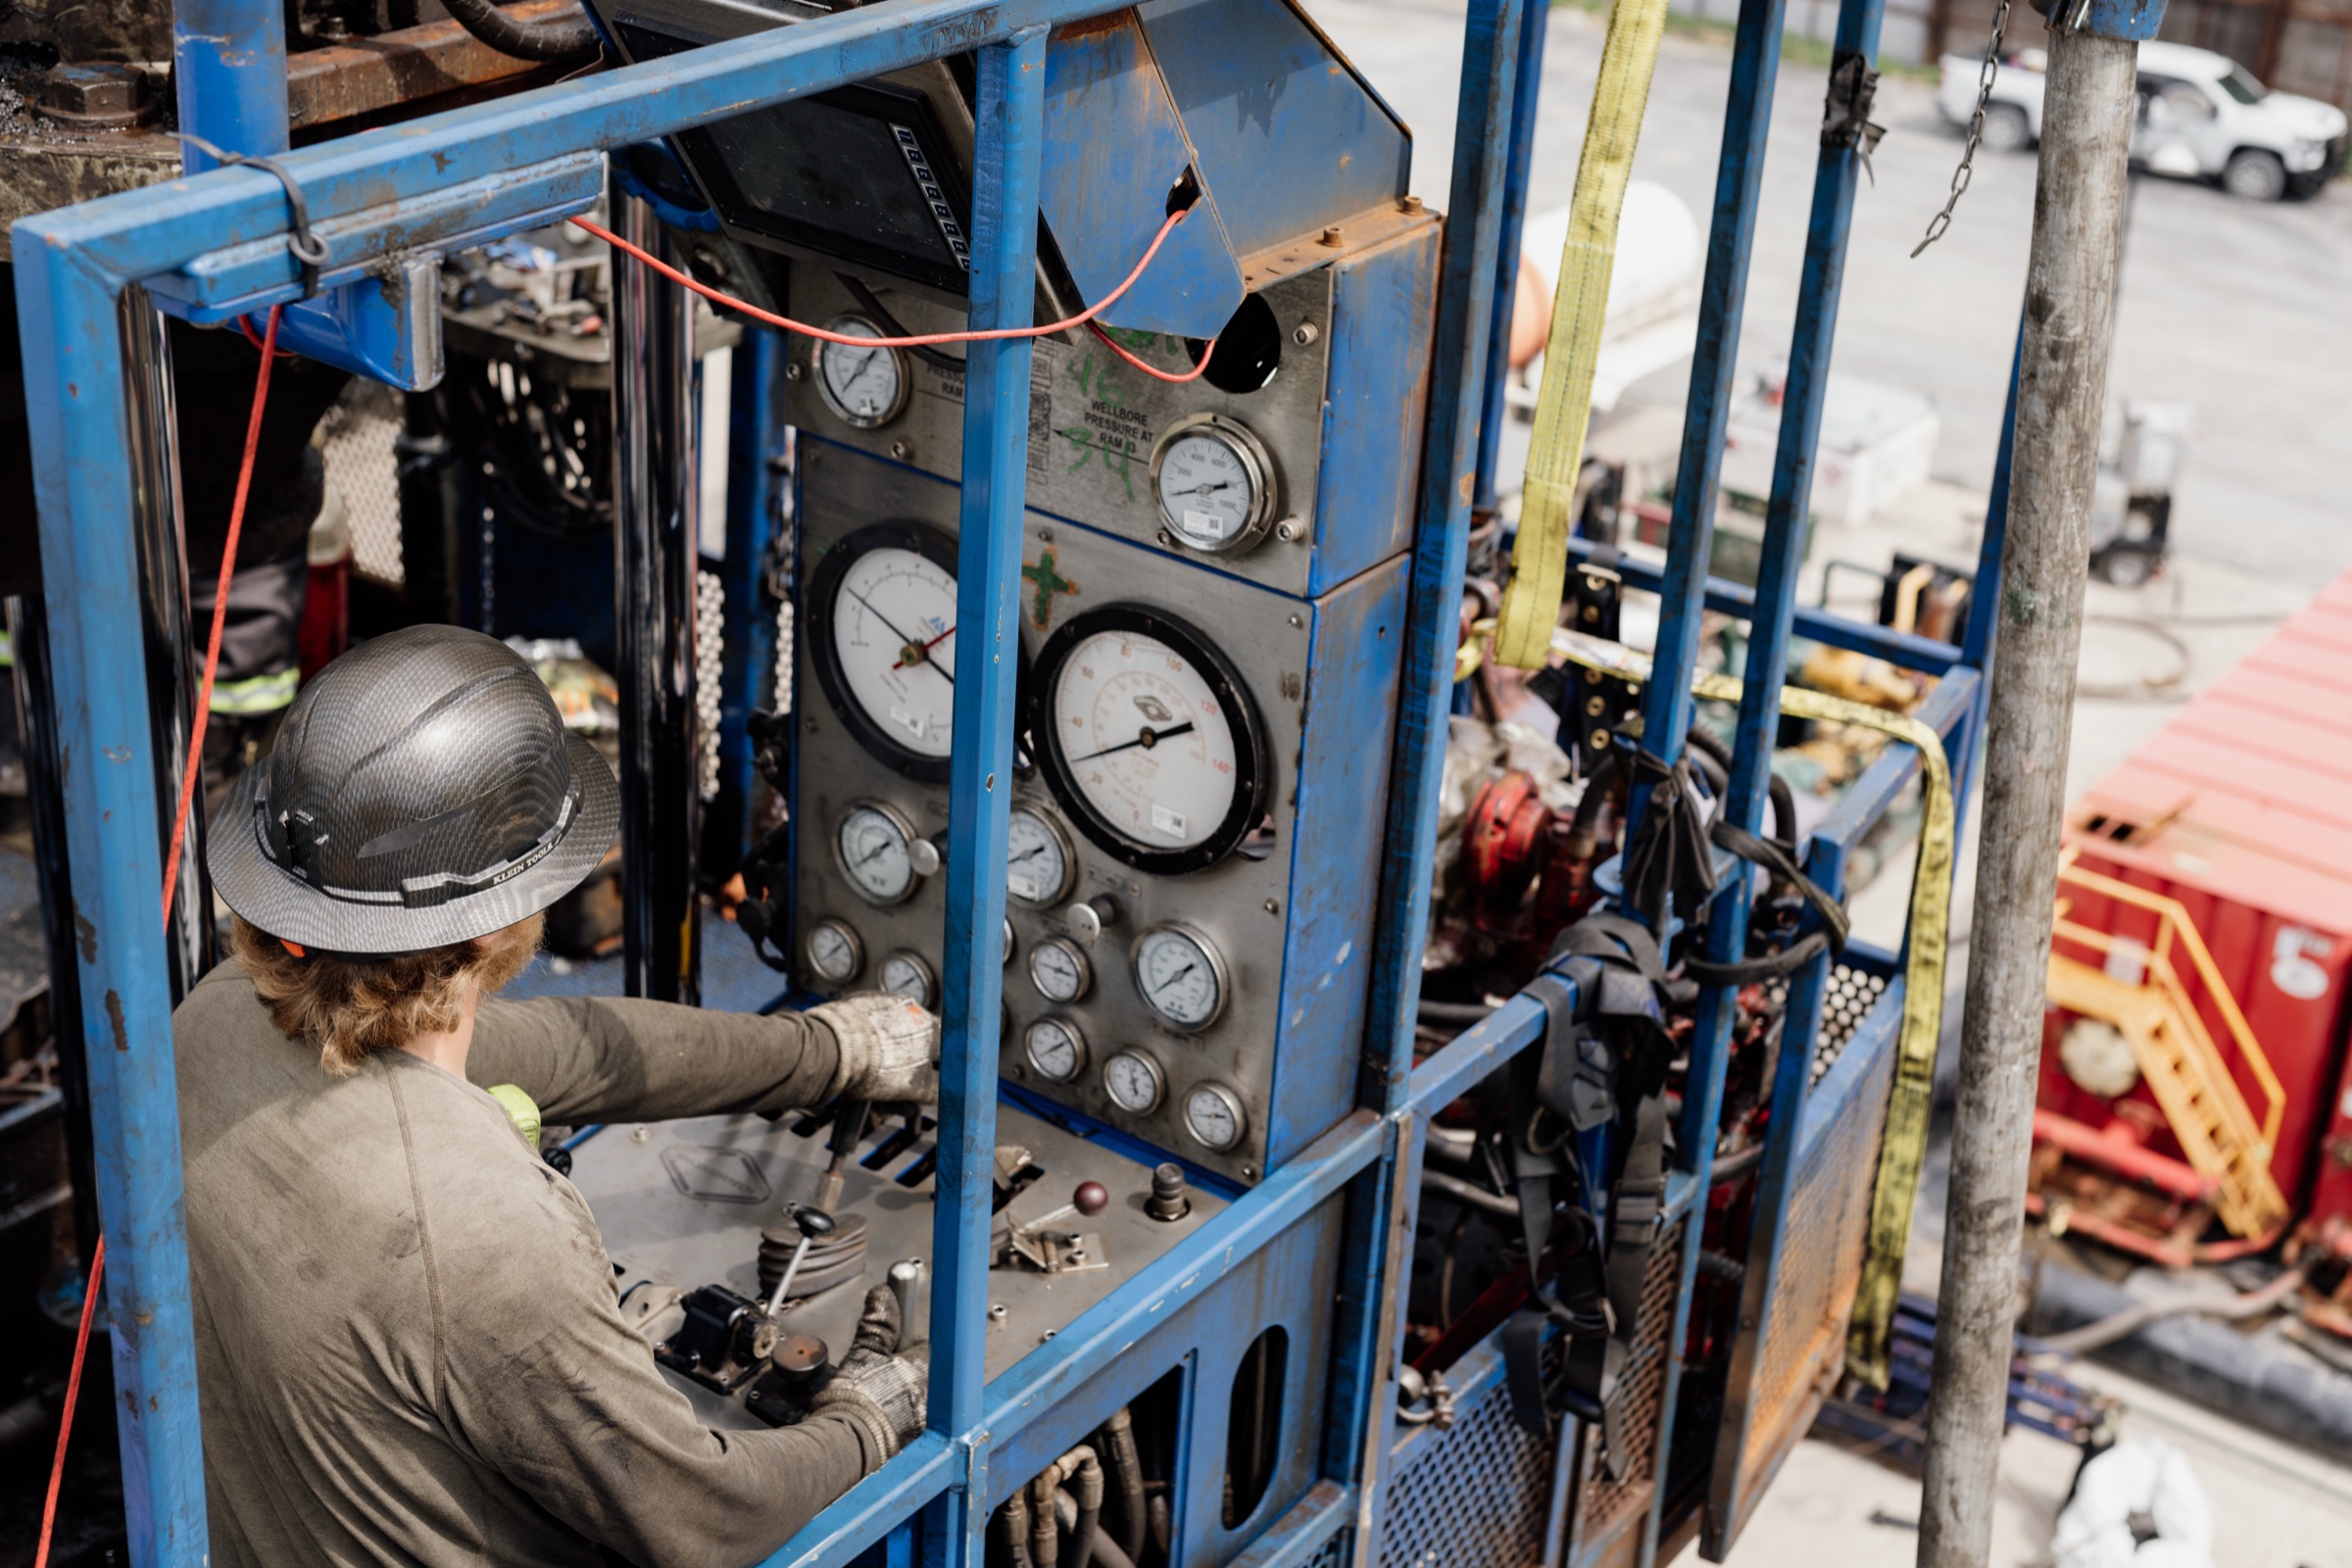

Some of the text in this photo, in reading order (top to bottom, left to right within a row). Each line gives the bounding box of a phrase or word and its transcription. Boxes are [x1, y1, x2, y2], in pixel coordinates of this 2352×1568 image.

[1091, 399, 1148, 425] WELLBORE
[1084, 413, 1153, 443] PRESSURE AT
[1100, 433, 1122, 449] RAM
[1082, 666, 1095, 679] 60
[1165, 657, 1183, 672] 100
[1200, 699, 1218, 715] 120
[1212, 758, 1230, 774] 140
[493, 863, 524, 885] KLEIN
